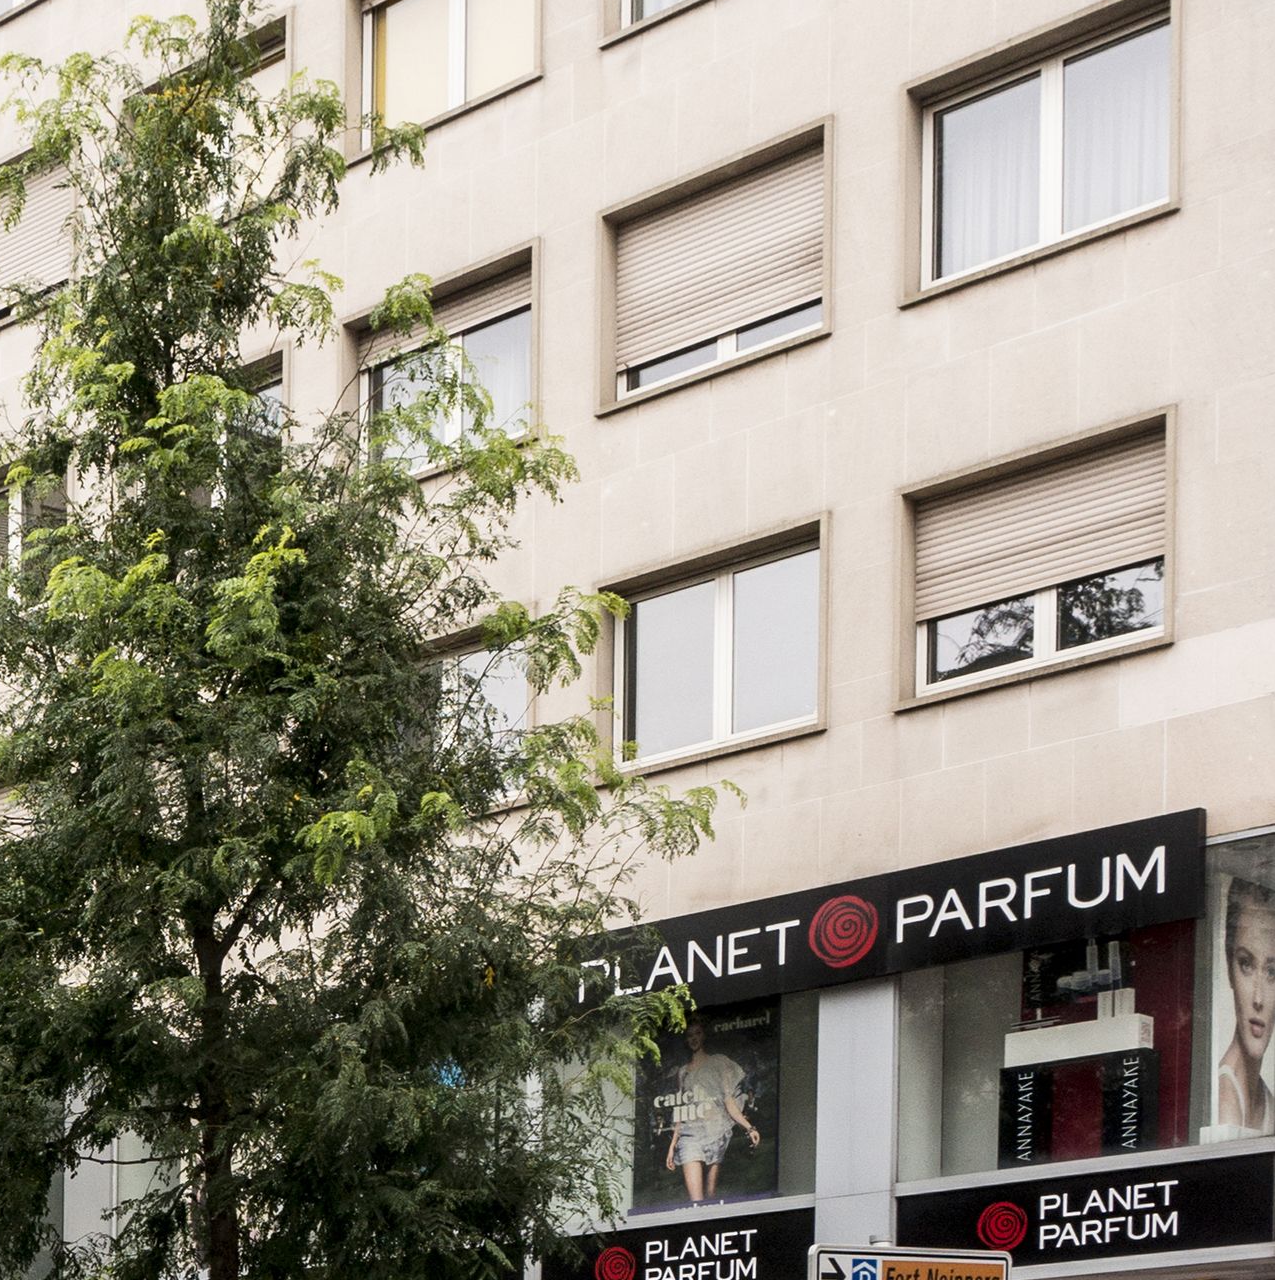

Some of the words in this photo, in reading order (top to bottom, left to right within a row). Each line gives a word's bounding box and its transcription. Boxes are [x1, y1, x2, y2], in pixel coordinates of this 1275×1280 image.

[579, 920, 800, 1003] PLANET
[896, 845, 1166, 944] PARFUM
[713, 1010, 771, 1033] cacharel
[1017, 1071, 1033, 1161] ANNAYAKE
[1121, 1056, 1139, 1149] ANNAYAKE
[1039, 1180, 1178, 1220] PLANET
[645, 1229, 757, 1263] PLANET
[1039, 1211, 1178, 1250] PARFUM
